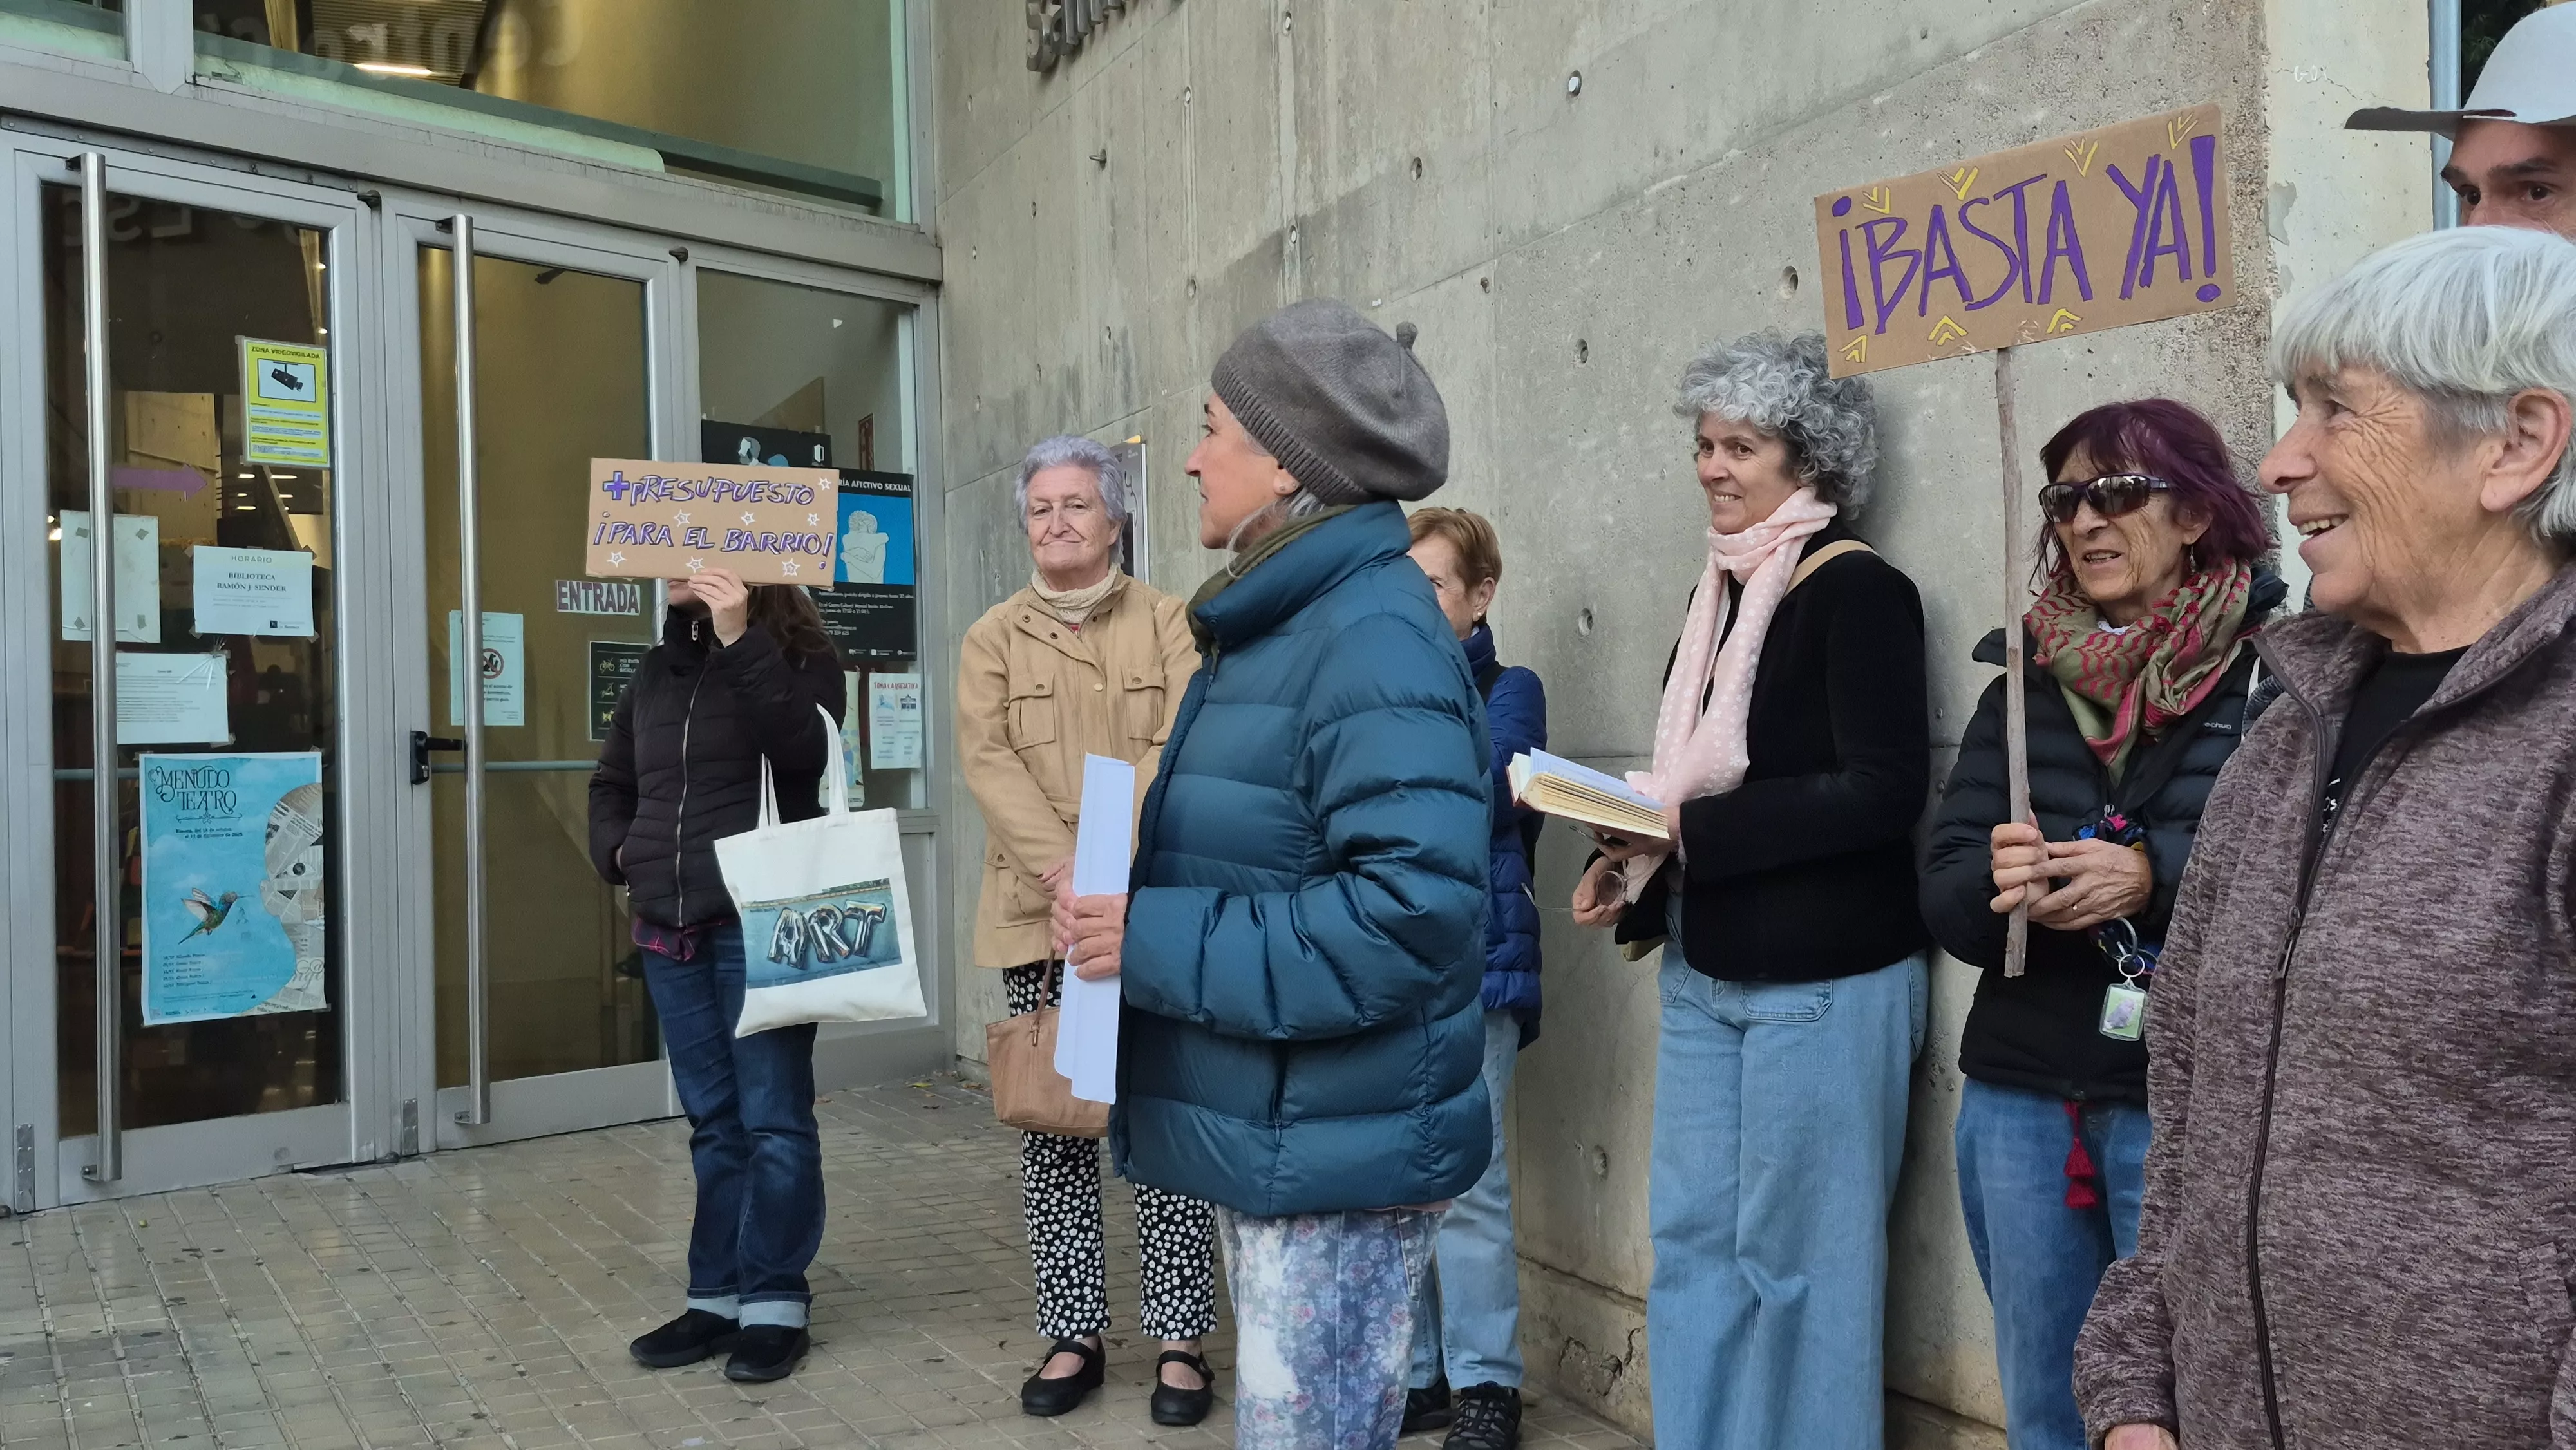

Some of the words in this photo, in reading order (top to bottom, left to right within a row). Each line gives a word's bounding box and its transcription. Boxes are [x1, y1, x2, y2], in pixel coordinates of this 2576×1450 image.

[1832, 173, 2093, 335] ¡BASTA
[2106, 134, 2222, 303] YA!
[271, 348, 320, 359] VIDEOVIGILADA
[851, 480, 883, 490] AFECTIVO
[884, 483, 911, 492] SEXUAL
[593, 511, 674, 548] ¡PARA
[682, 527, 715, 549] EL
[719, 528, 834, 570] BARRIO!
[231, 555, 272, 563] HORARIO
[229, 572, 276, 581] BIBLIOTECA
[558, 581, 639, 613] ENTRADA
[156, 765, 230, 798] MENUDO
[177, 790, 237, 814] TEATRO
[766, 899, 887, 970] ART
